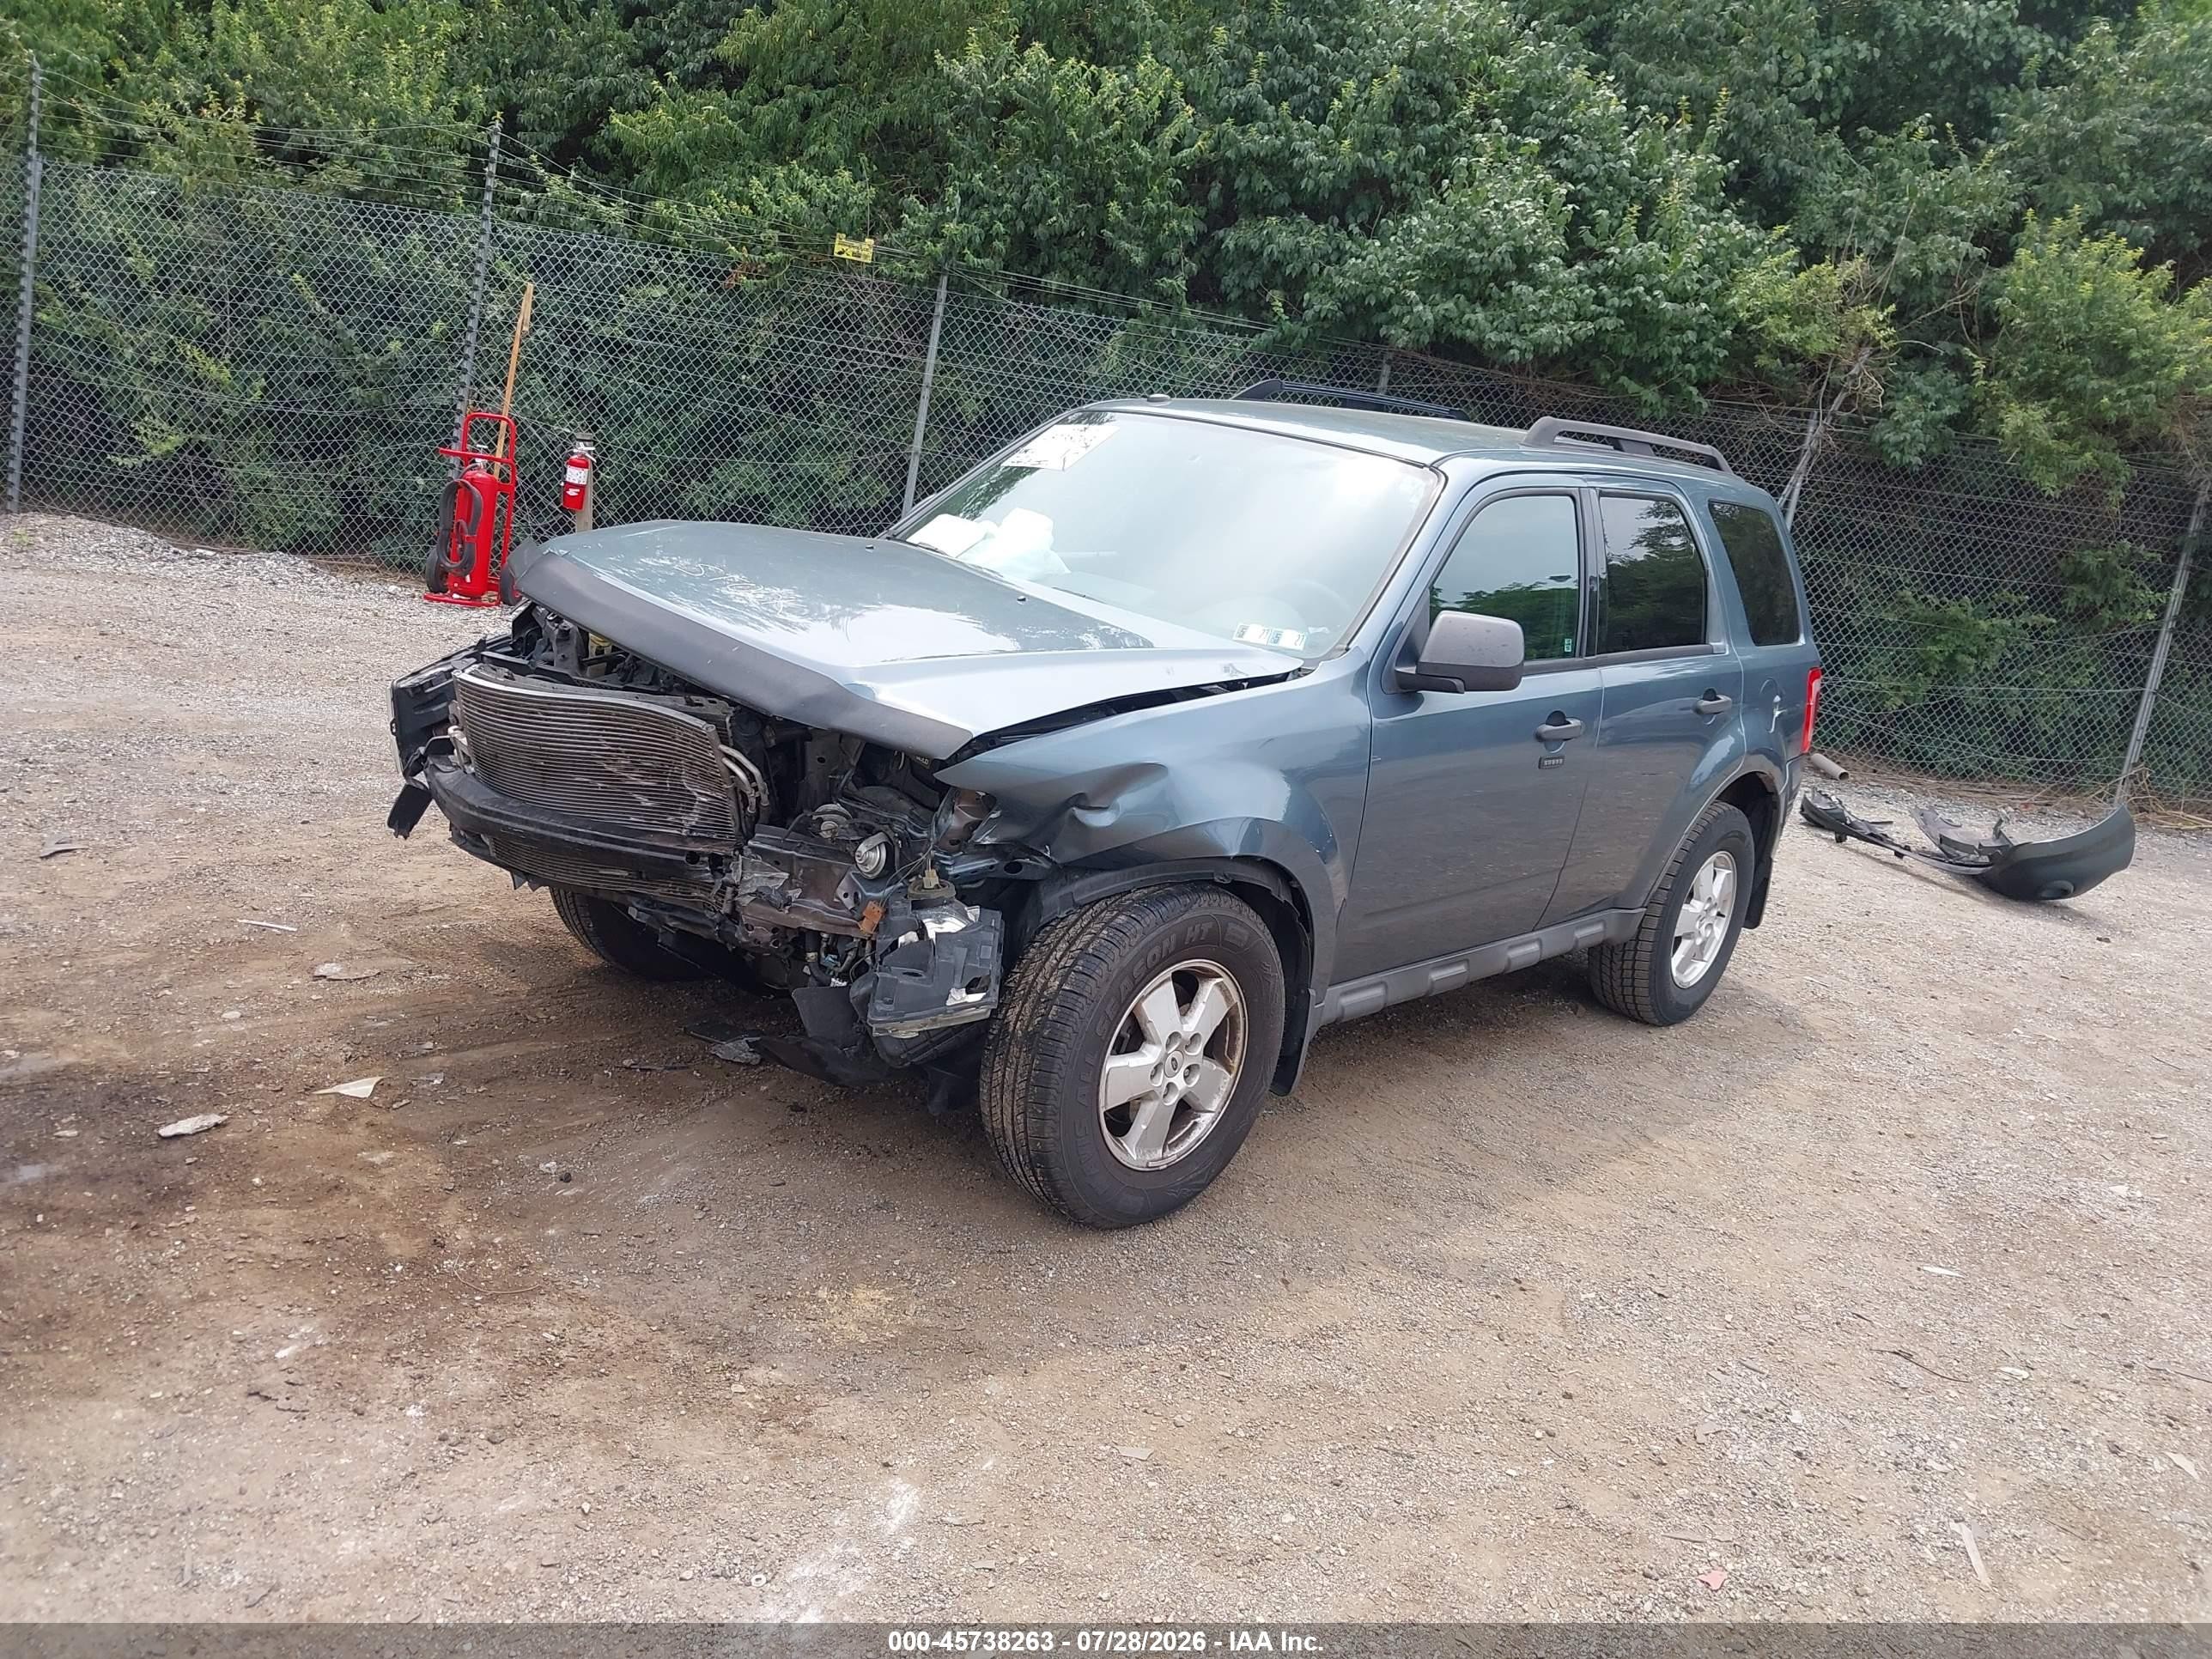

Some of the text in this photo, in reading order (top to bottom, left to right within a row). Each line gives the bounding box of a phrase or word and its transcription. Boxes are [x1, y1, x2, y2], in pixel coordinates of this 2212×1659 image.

[1076, 1049, 1099, 1107] ALL
[1095, 933, 1176, 1037] SEASON
[1184, 921, 1216, 945] HT
